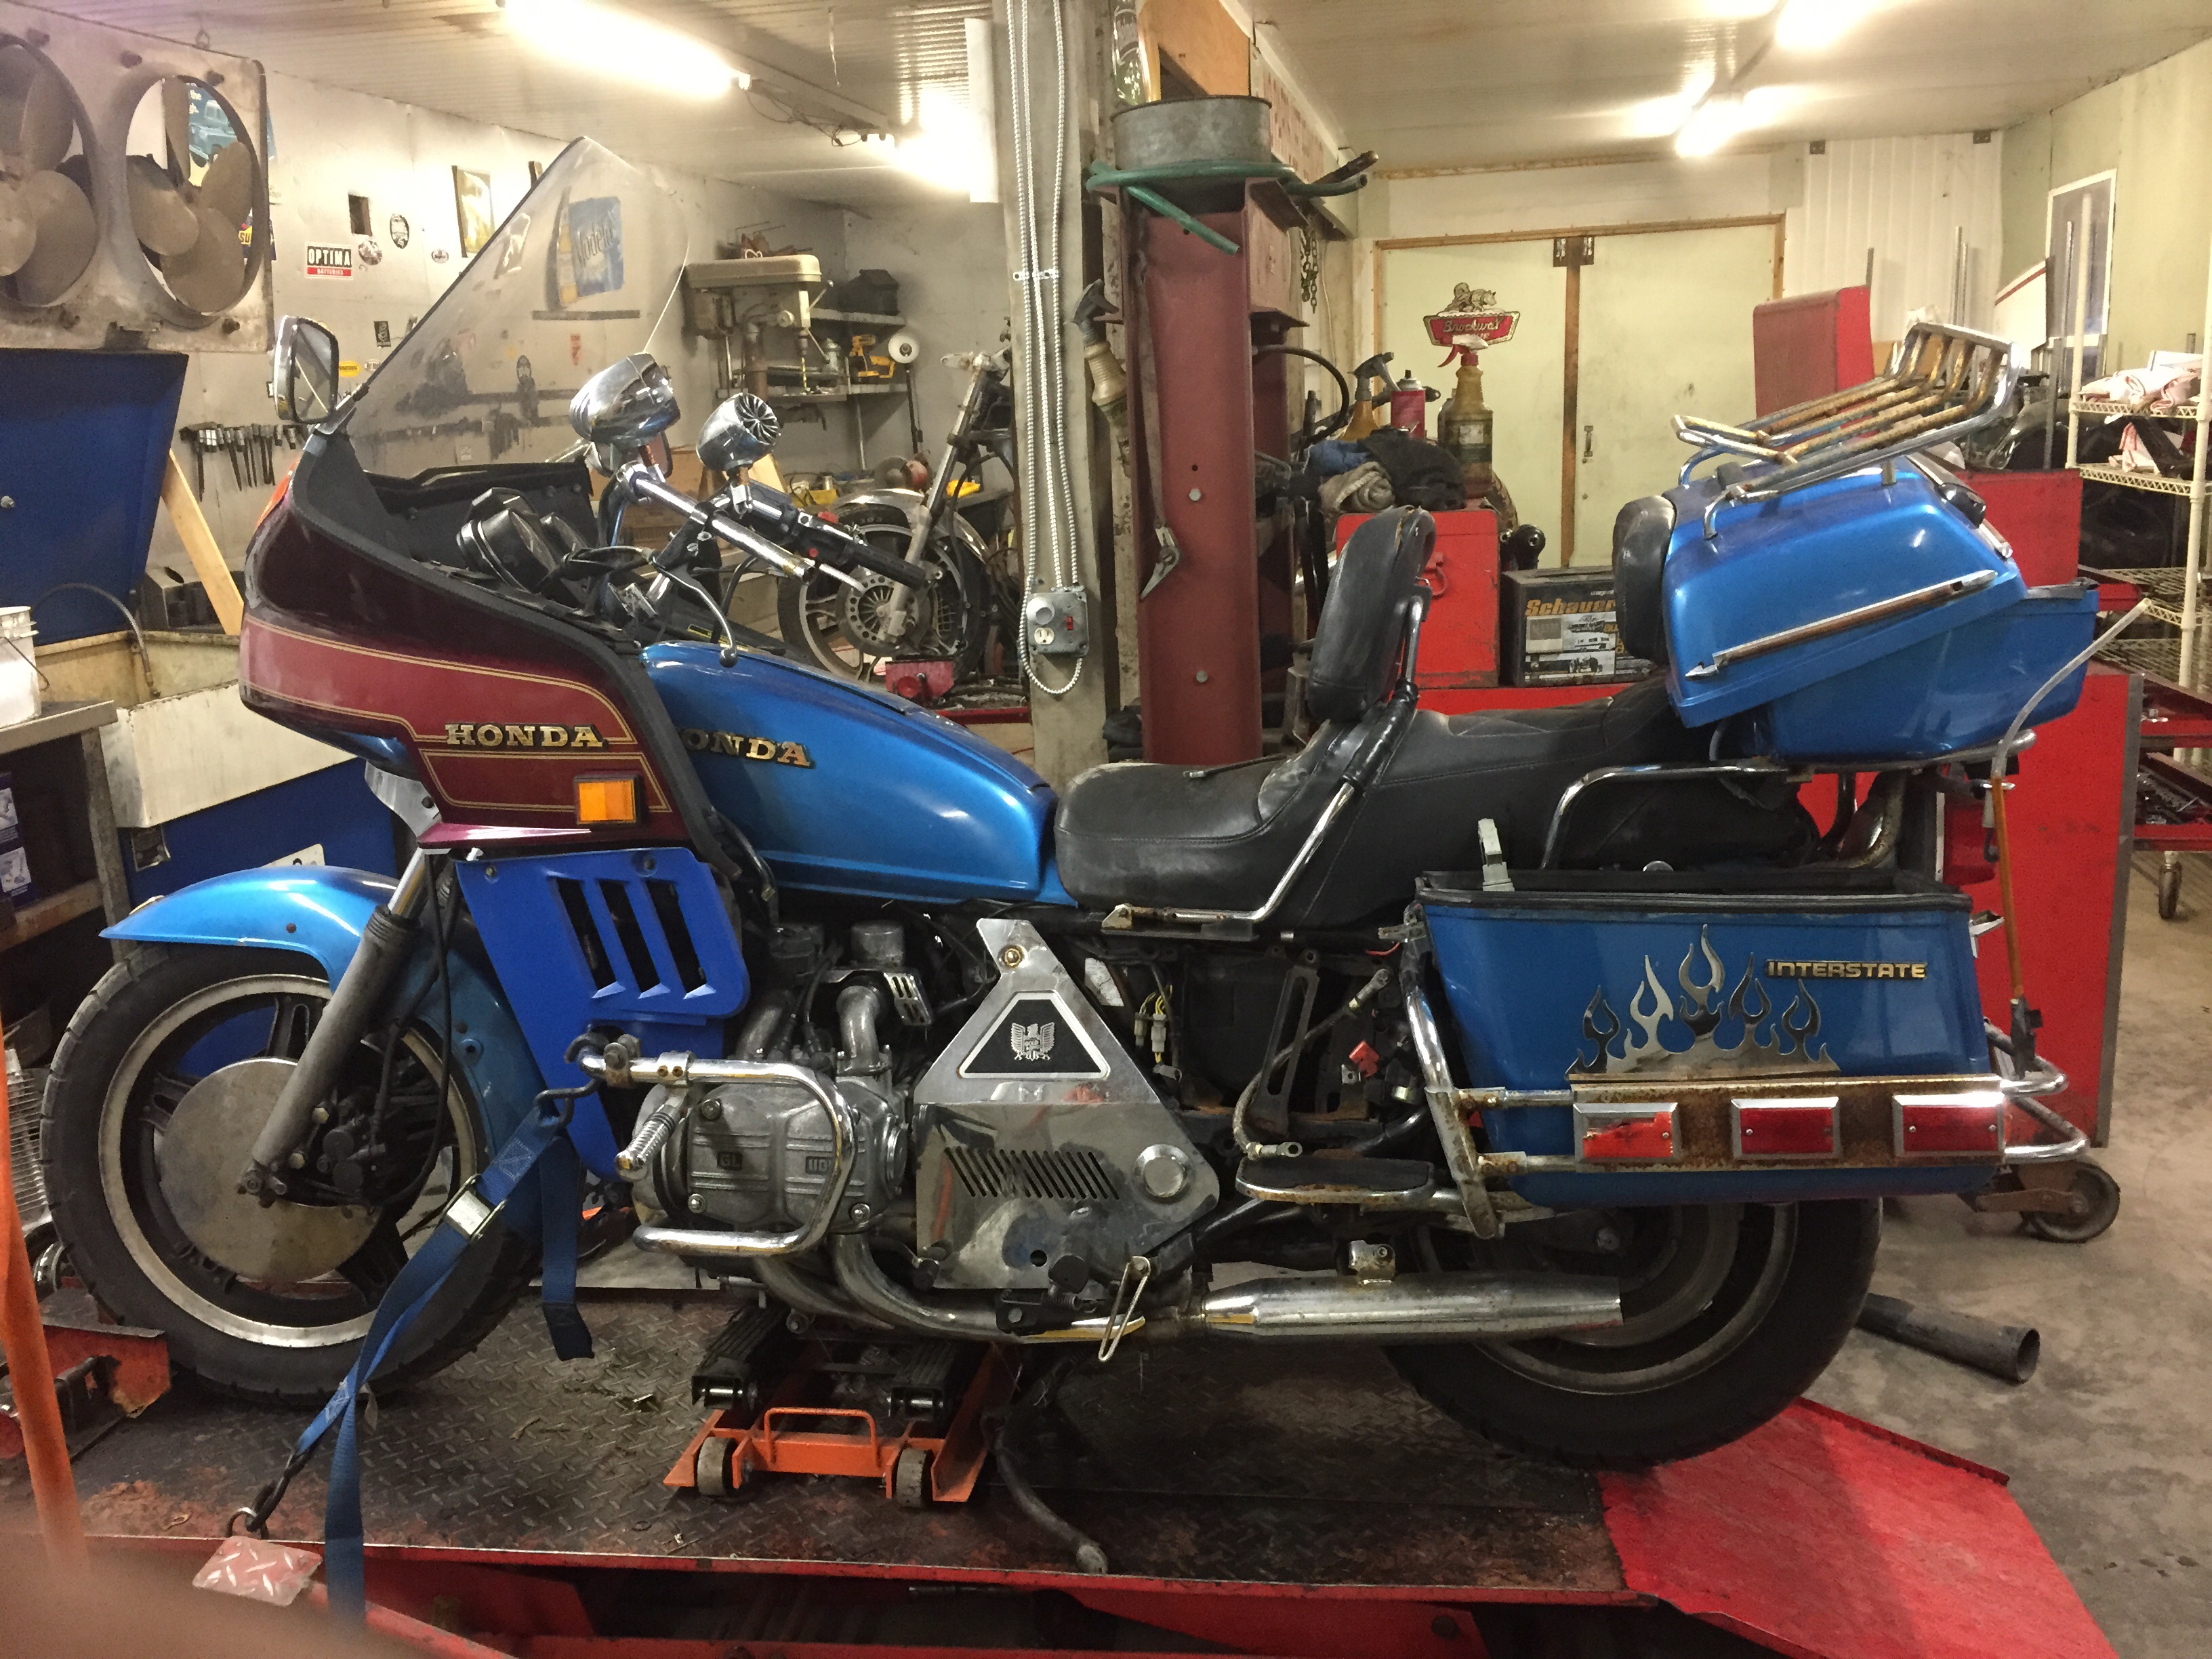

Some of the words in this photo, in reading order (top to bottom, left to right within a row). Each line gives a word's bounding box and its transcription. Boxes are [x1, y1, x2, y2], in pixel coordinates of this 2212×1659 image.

[239, 232, 251, 243] SU
[308, 248, 350, 266] OPTIMA
[1525, 598, 1616, 616] Schauer
[445, 724, 603, 747] HONDA
[680, 729, 811, 767] ONDA
[1767, 962, 1926, 979] INTERSTATE
[720, 1154, 741, 1168] GL
[808, 1158, 832, 1174] 110
